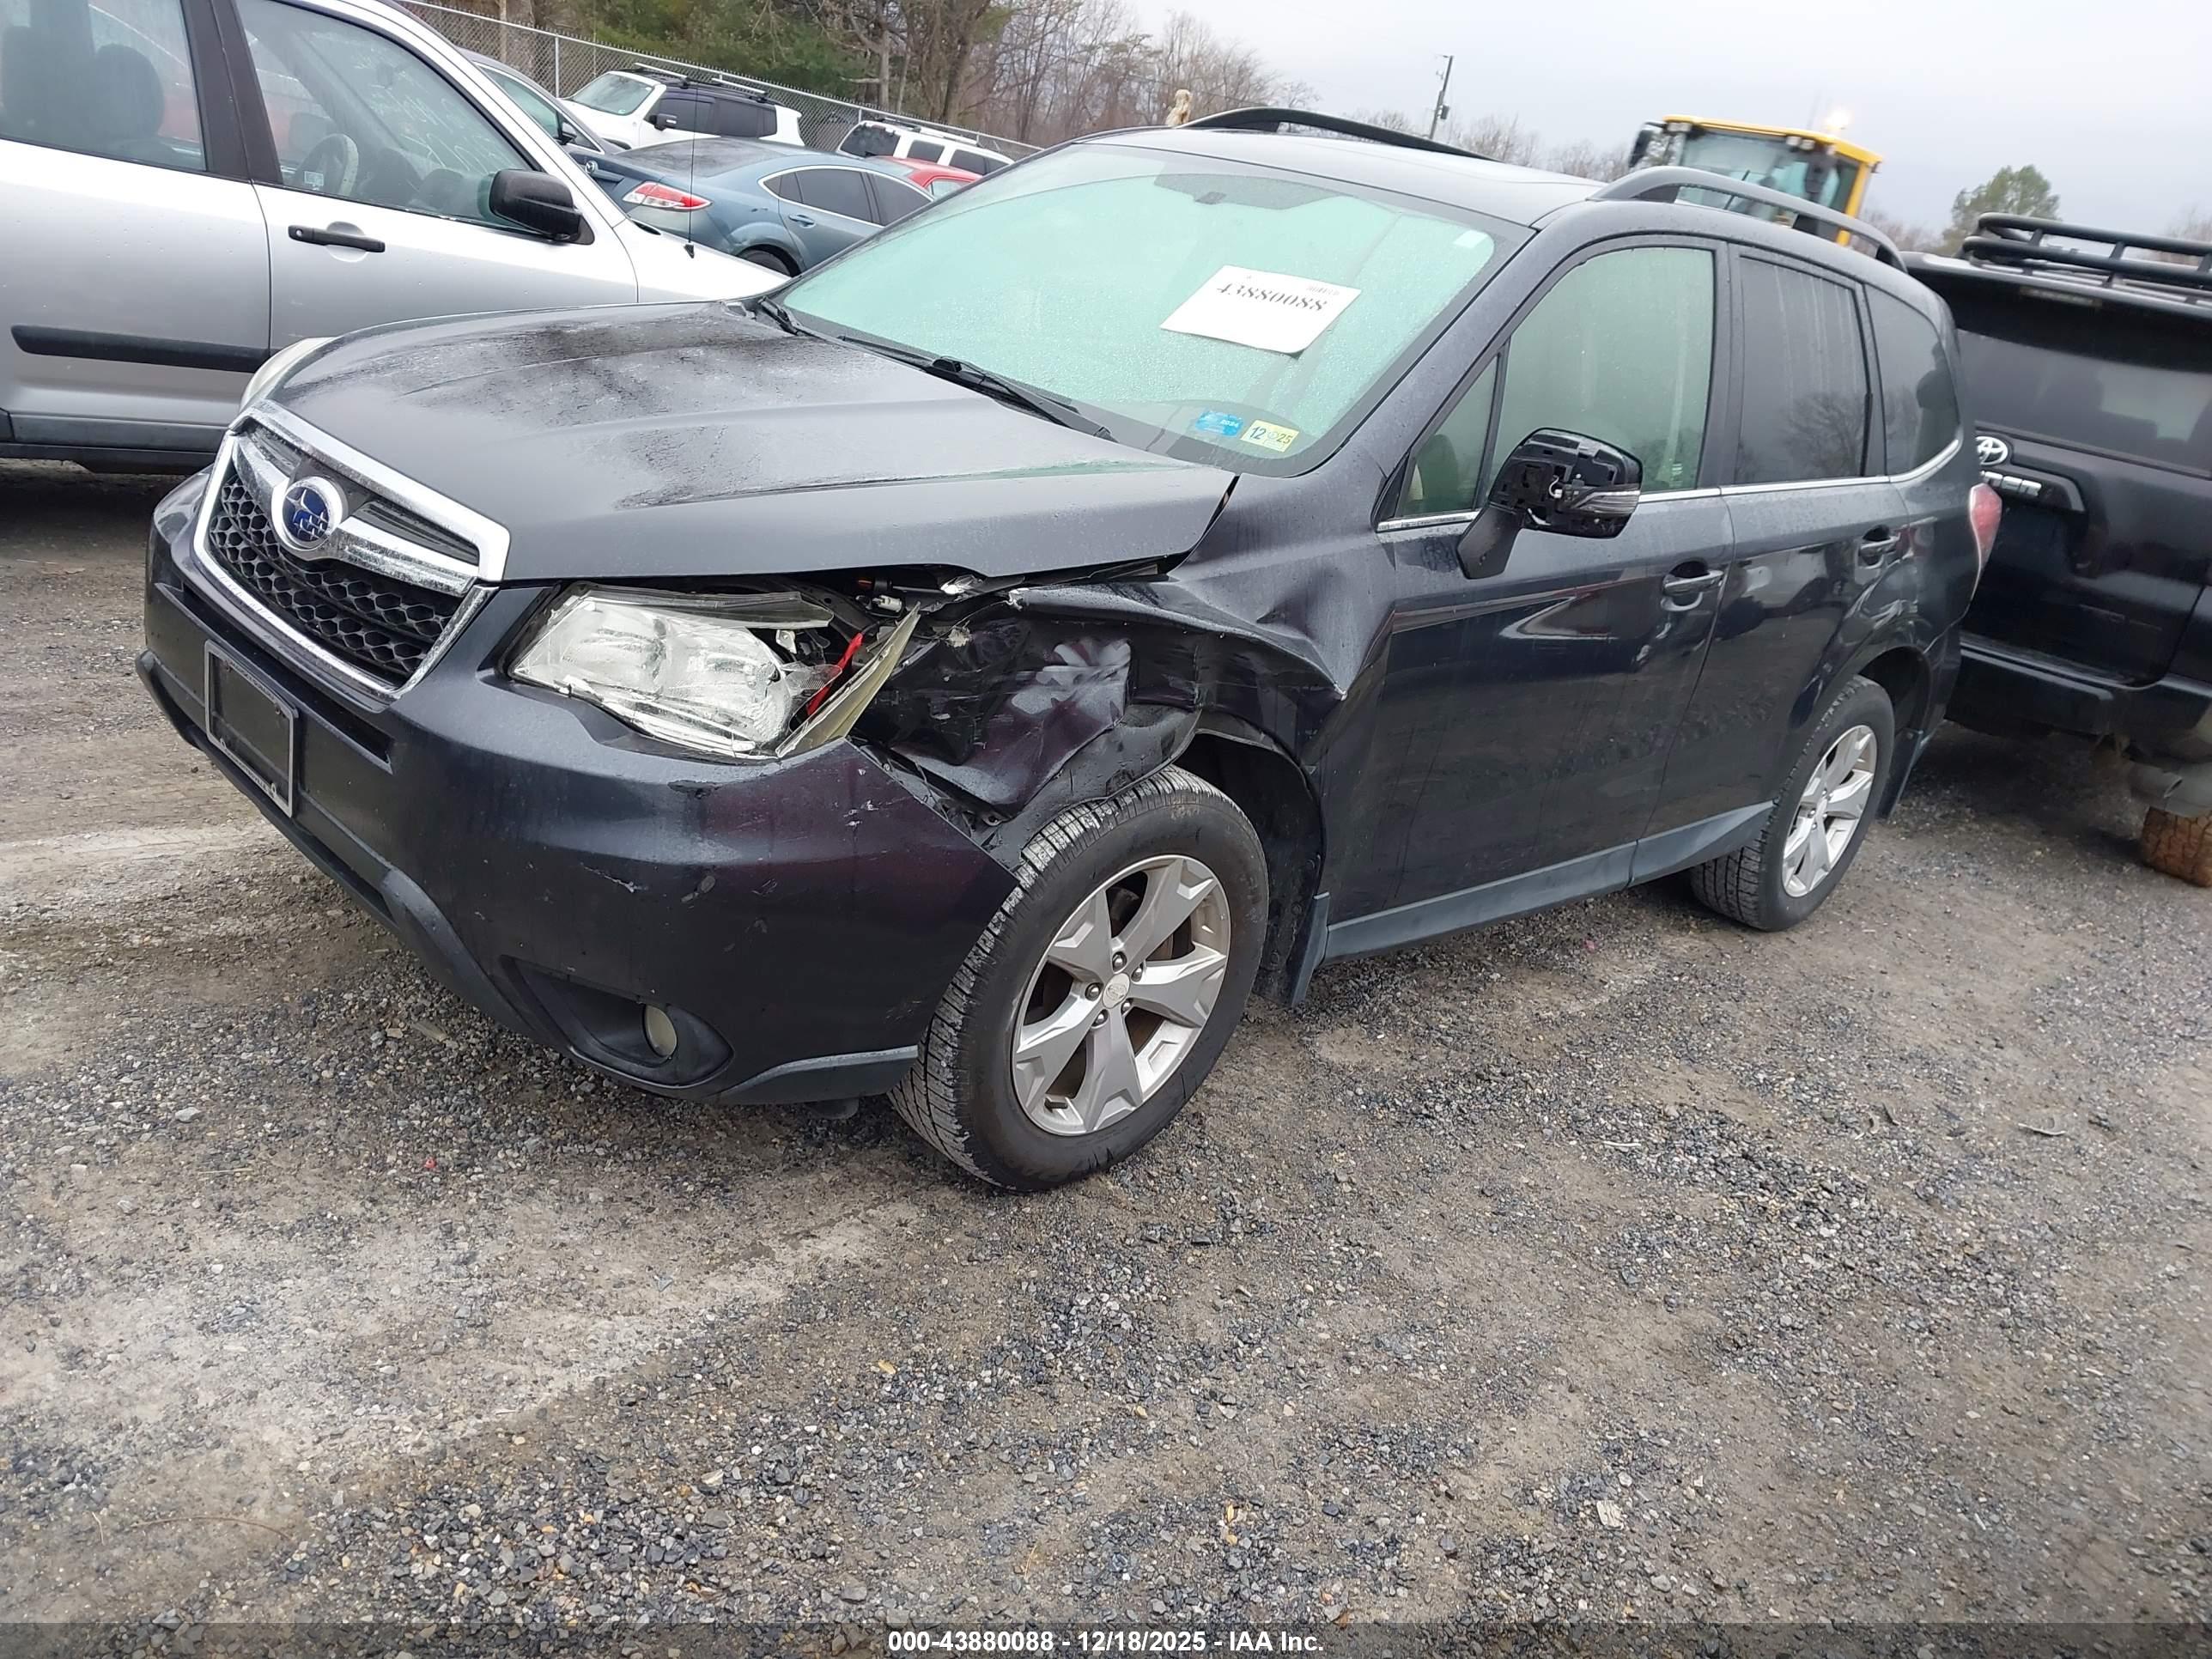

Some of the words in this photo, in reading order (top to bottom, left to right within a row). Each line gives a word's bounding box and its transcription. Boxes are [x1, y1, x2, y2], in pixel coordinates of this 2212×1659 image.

[1217, 283, 1328, 311] 43880088
[1249, 426, 1267, 440] 12
[1275, 434, 1293, 445] 25
